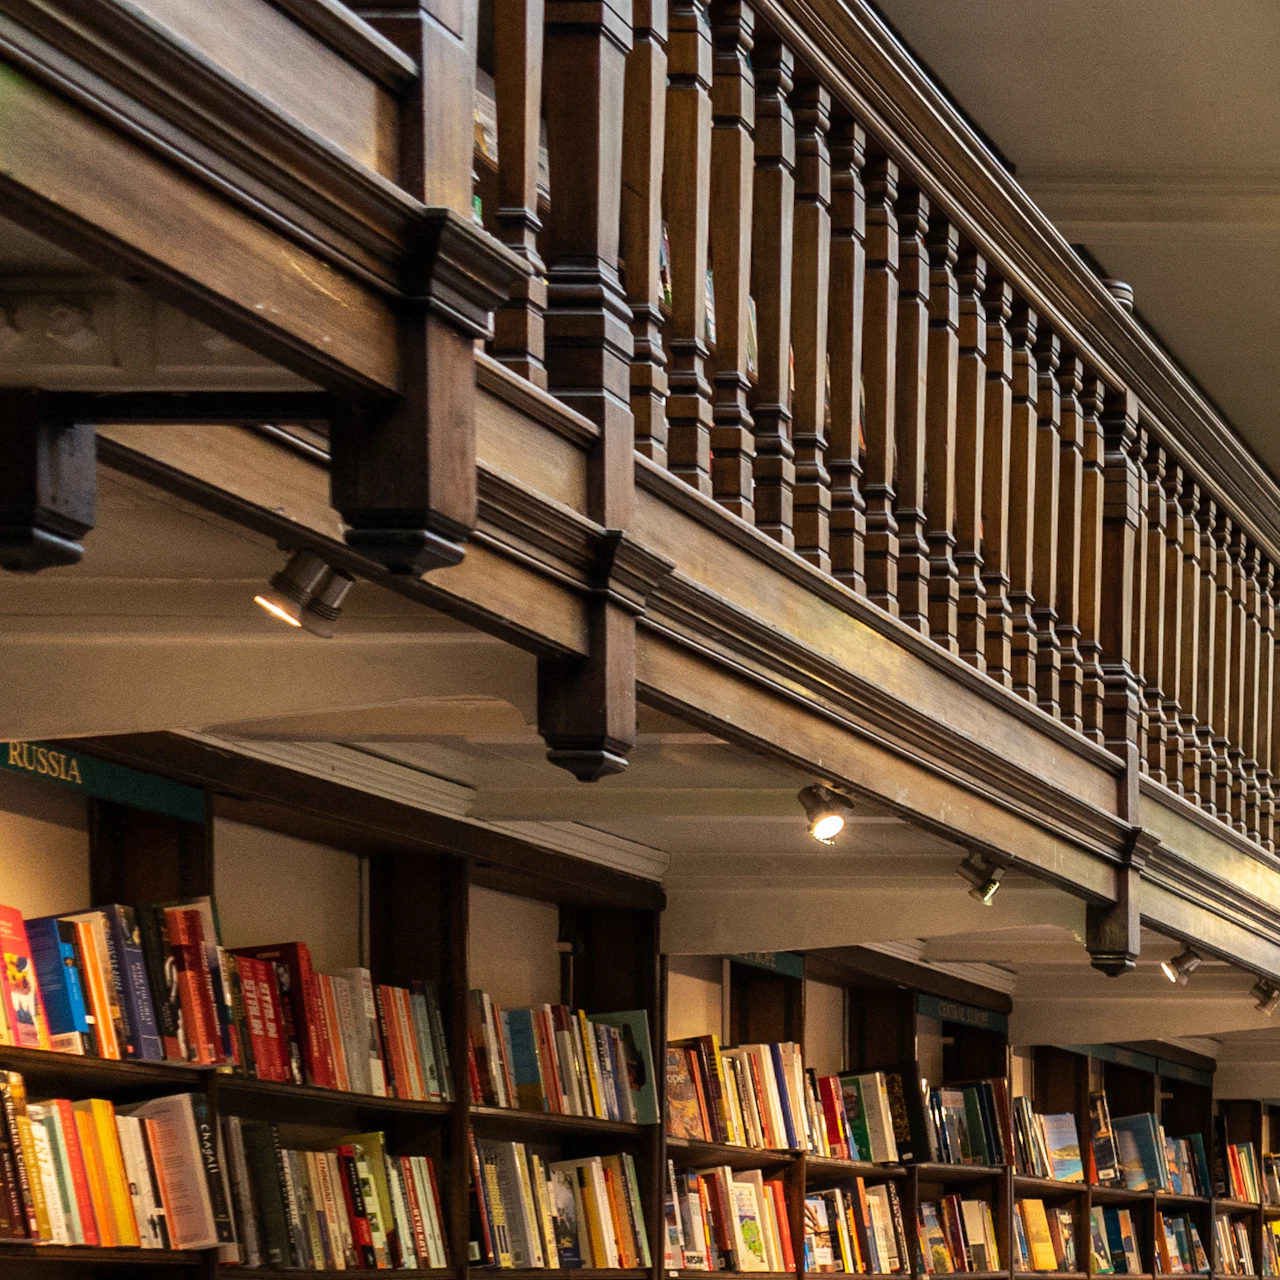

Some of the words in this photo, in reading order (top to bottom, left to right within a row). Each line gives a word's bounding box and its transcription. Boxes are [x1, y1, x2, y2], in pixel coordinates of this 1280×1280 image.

[8, 741, 83, 785] RUSSIA
[244, 979, 263, 1036] STALIN
[259, 982, 278, 1039] STALIN
